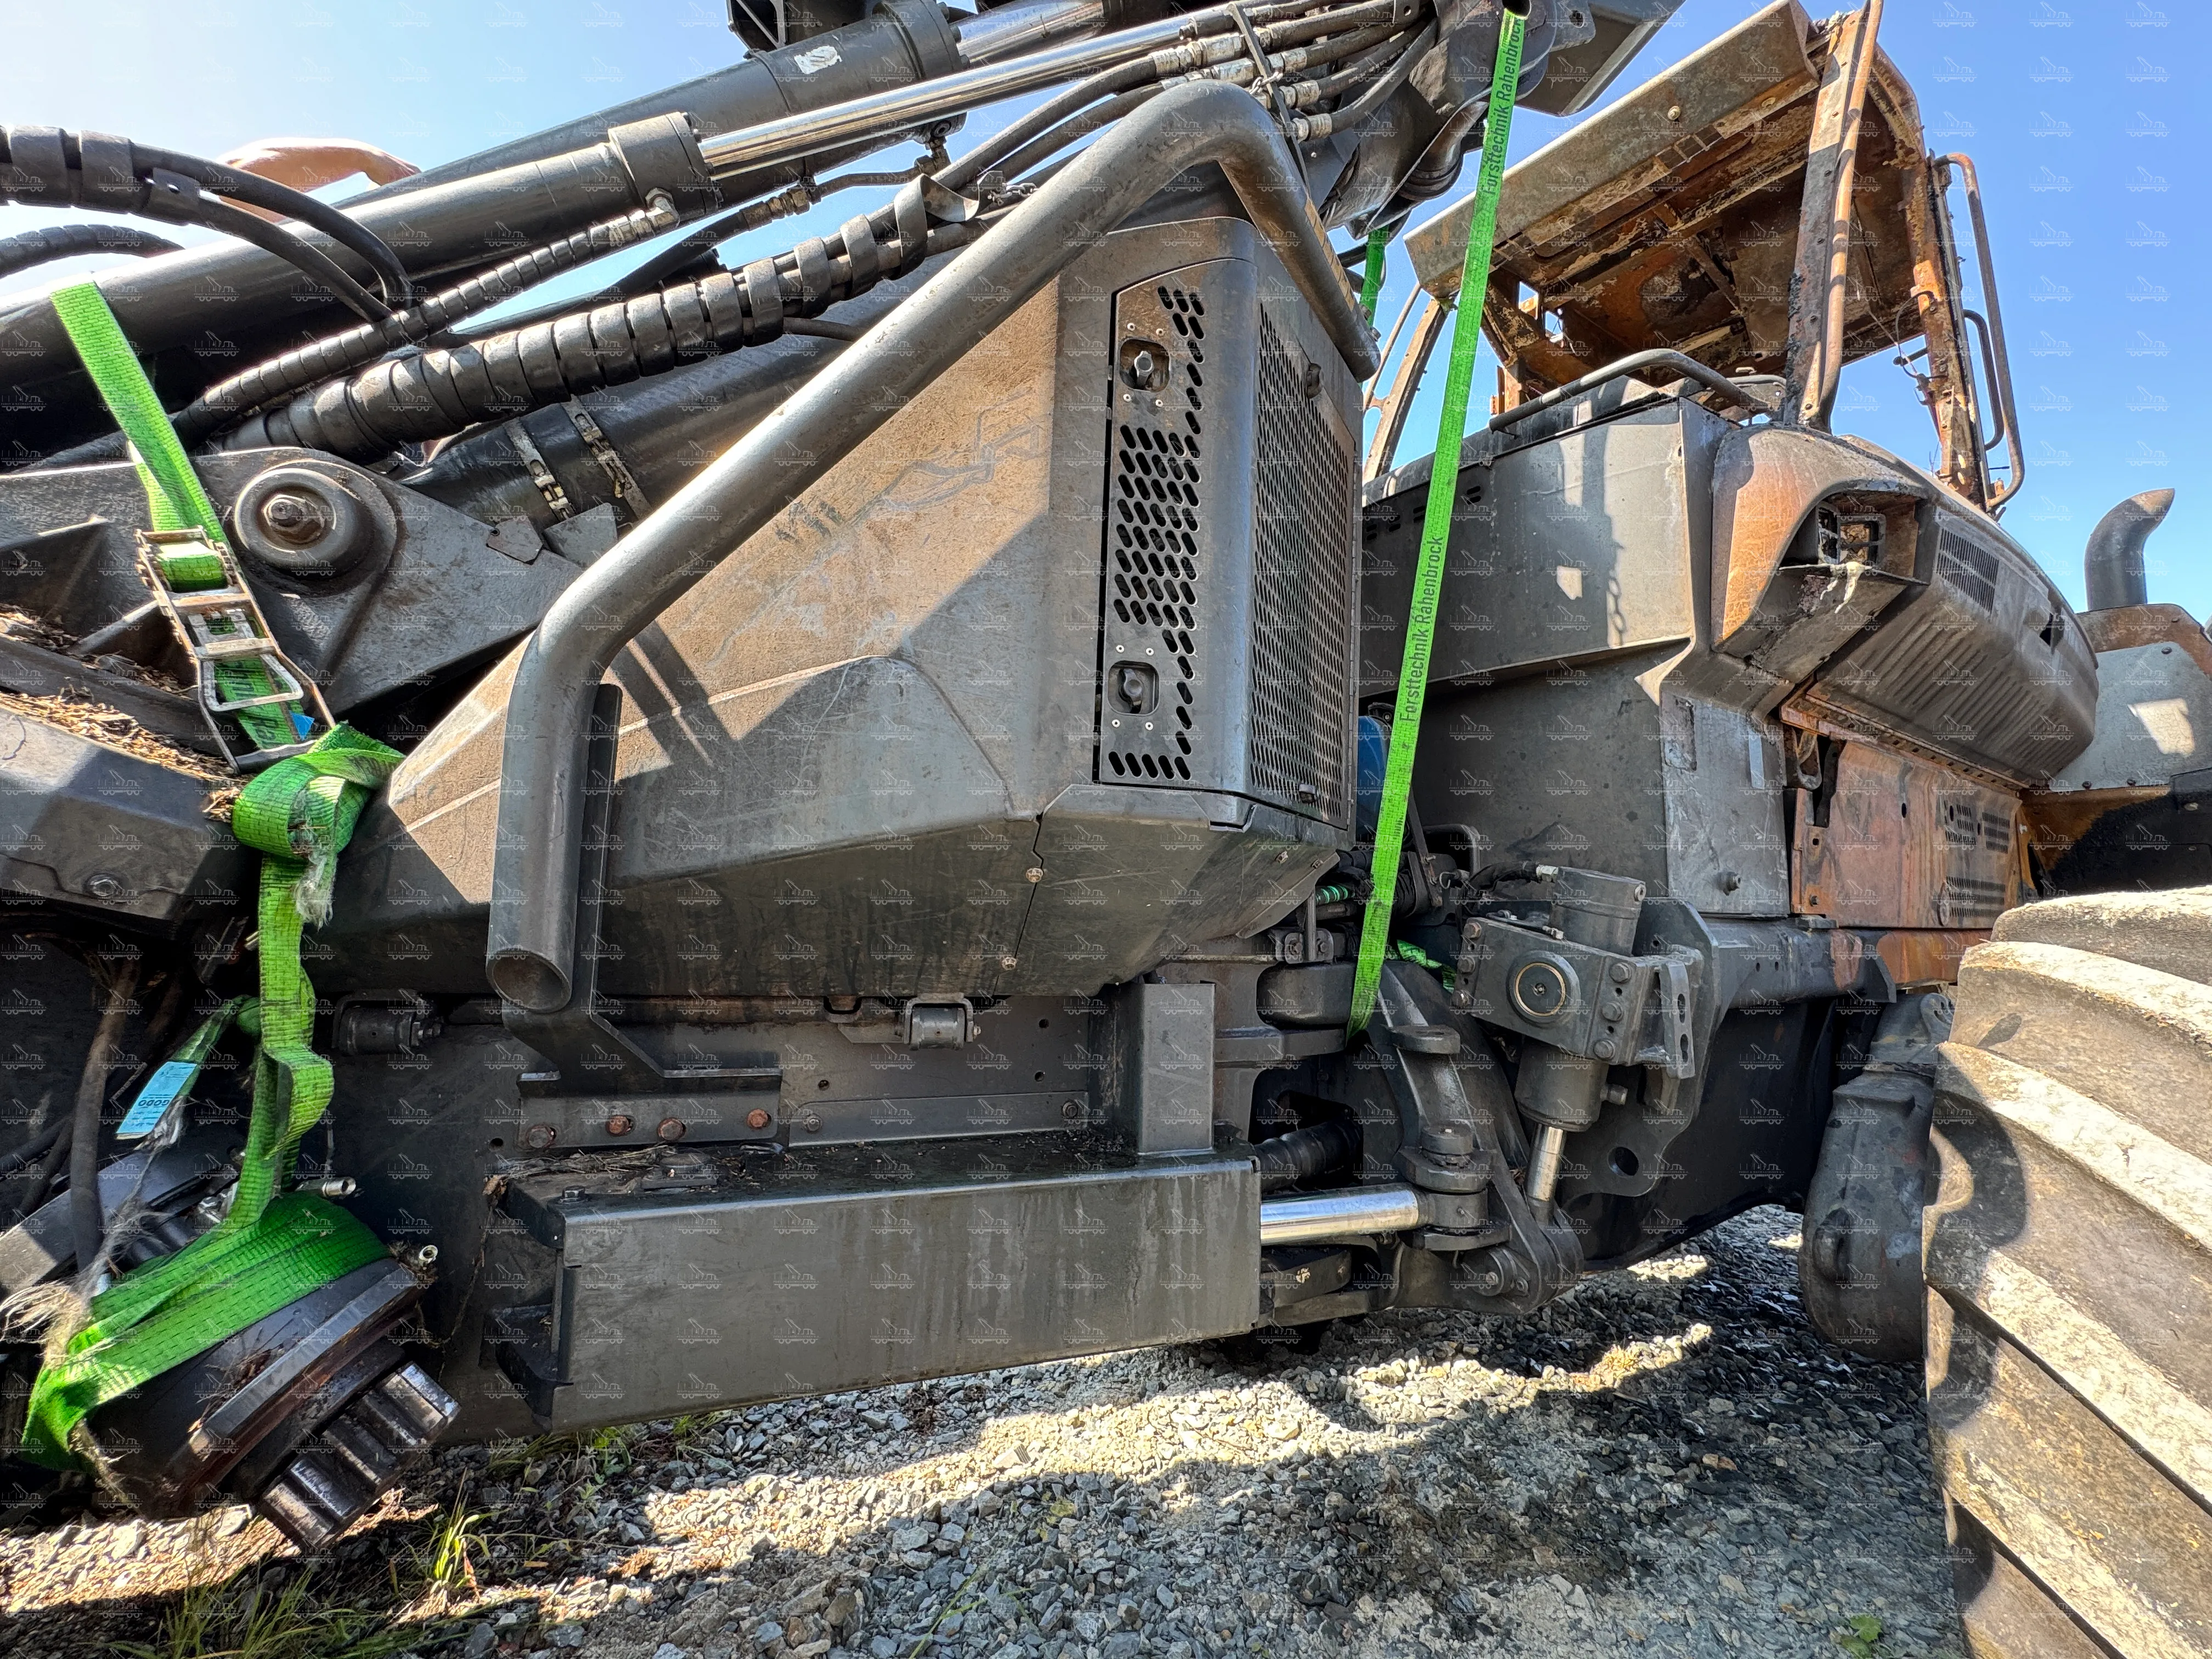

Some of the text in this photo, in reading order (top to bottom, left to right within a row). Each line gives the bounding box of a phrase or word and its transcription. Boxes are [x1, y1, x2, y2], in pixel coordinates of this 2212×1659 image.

[1483, 104, 1510, 198] Forsttechnik
[1400, 537, 1443, 722] Forsttechnik Rahenbrock
